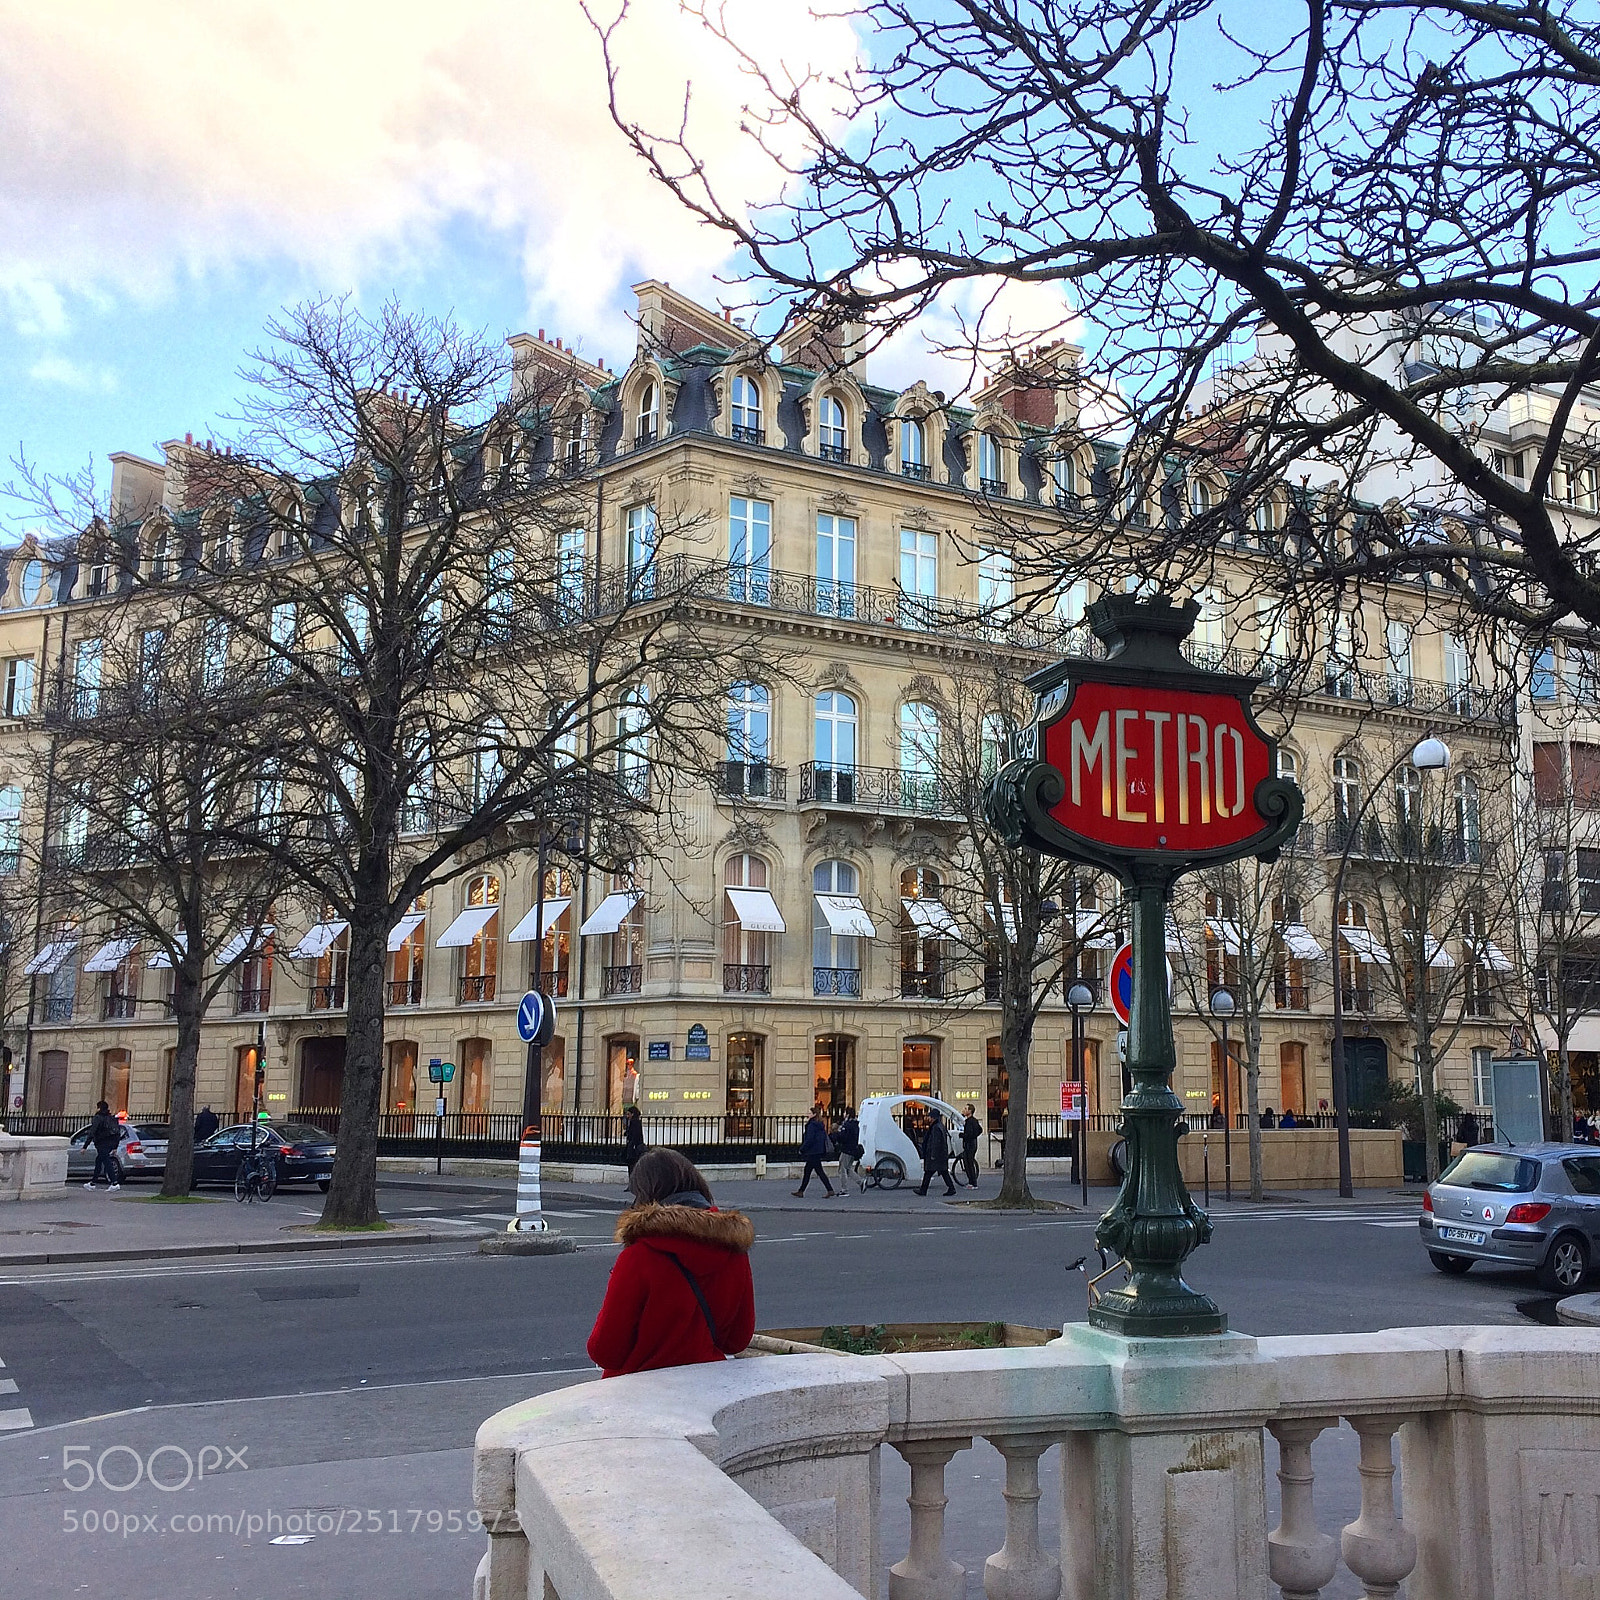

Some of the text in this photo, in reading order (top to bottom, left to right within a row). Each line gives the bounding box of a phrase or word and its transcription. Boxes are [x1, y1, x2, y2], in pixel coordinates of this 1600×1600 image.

[1071, 709, 1245, 824] METRO
[683, 1091, 711, 1099] GUCCI
[1484, 1208, 1492, 1218] A
